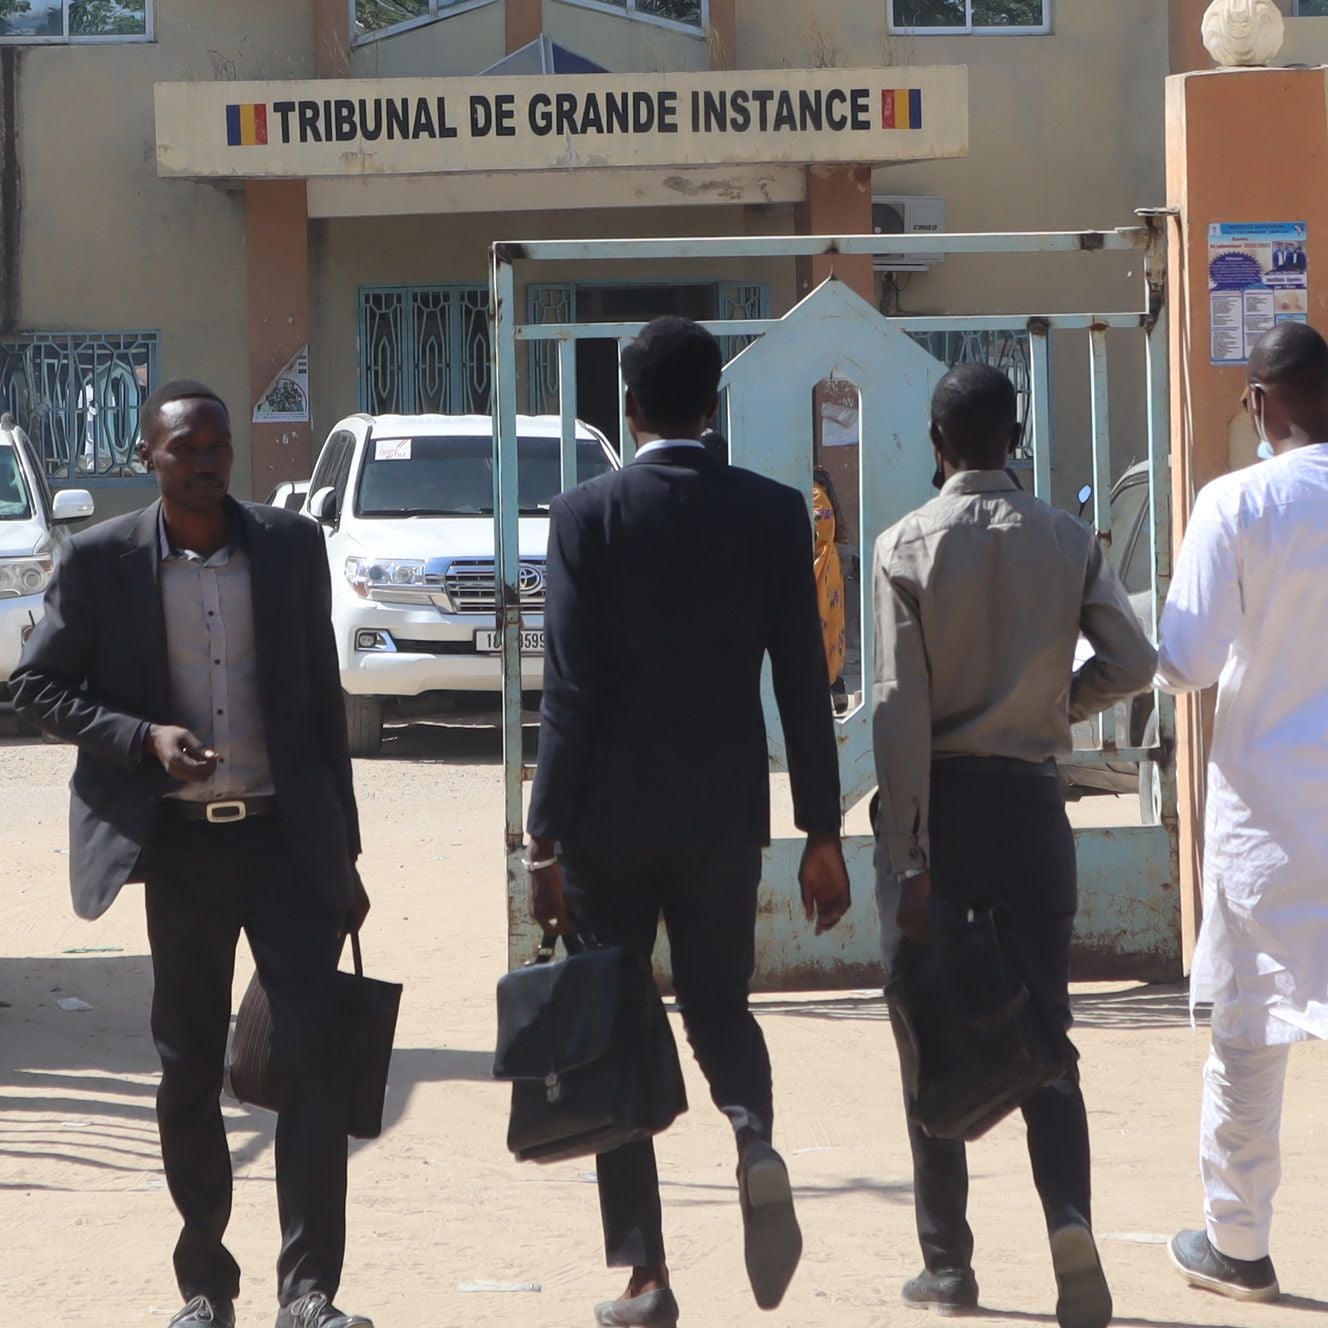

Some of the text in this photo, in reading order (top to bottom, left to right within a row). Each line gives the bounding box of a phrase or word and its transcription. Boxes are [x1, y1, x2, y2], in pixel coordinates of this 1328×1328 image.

[273, 88, 871, 144] TRIBUNAL DE GRANDE INSTANCE
